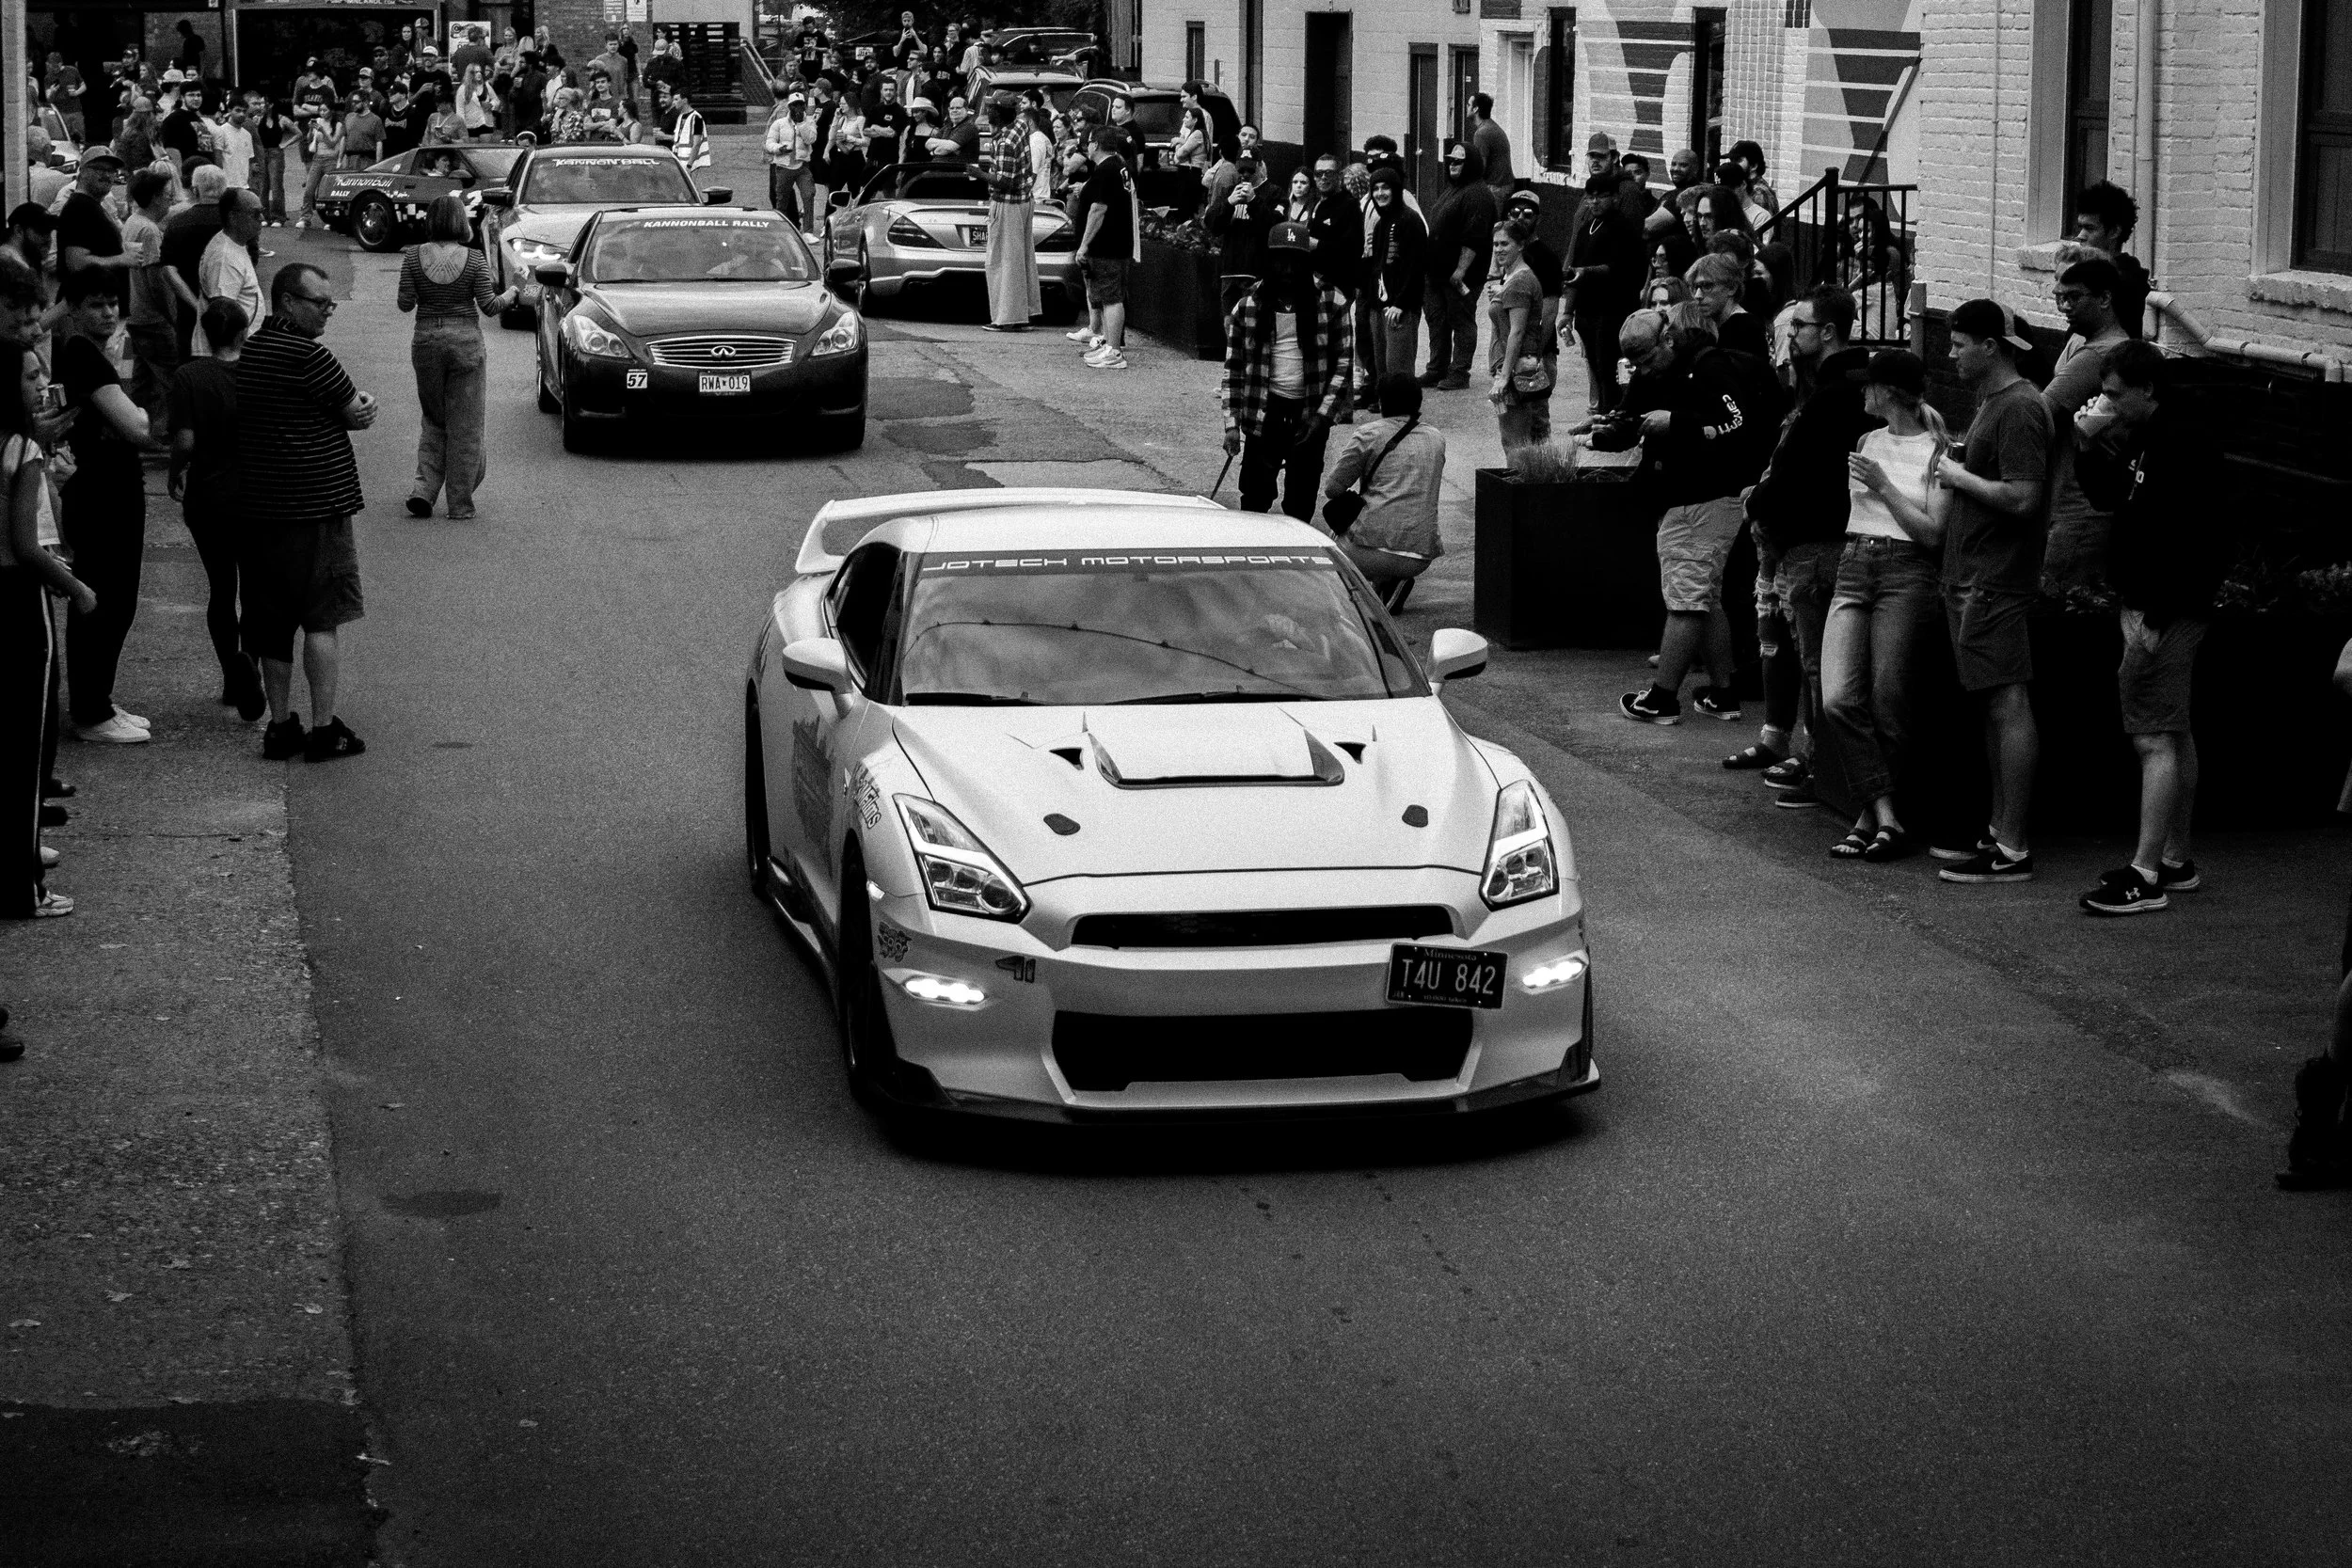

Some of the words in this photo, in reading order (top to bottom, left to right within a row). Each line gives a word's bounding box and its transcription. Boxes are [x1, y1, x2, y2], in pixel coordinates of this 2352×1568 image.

[644, 219, 728, 228] KANNONBALL
[732, 219, 770, 228] RALLY
[1287, 228, 1296, 242] LA
[628, 373, 646, 388] 57
[701, 376, 721, 389] RWA
[728, 376, 748, 389] 019
[923, 557, 1067, 572] JOTECH
[1081, 555, 1334, 566] MOTORSPORTS
[1423, 946, 1477, 961] Minnesota
[1402, 958, 1442, 990] T4U
[1454, 962, 1496, 994] 842
